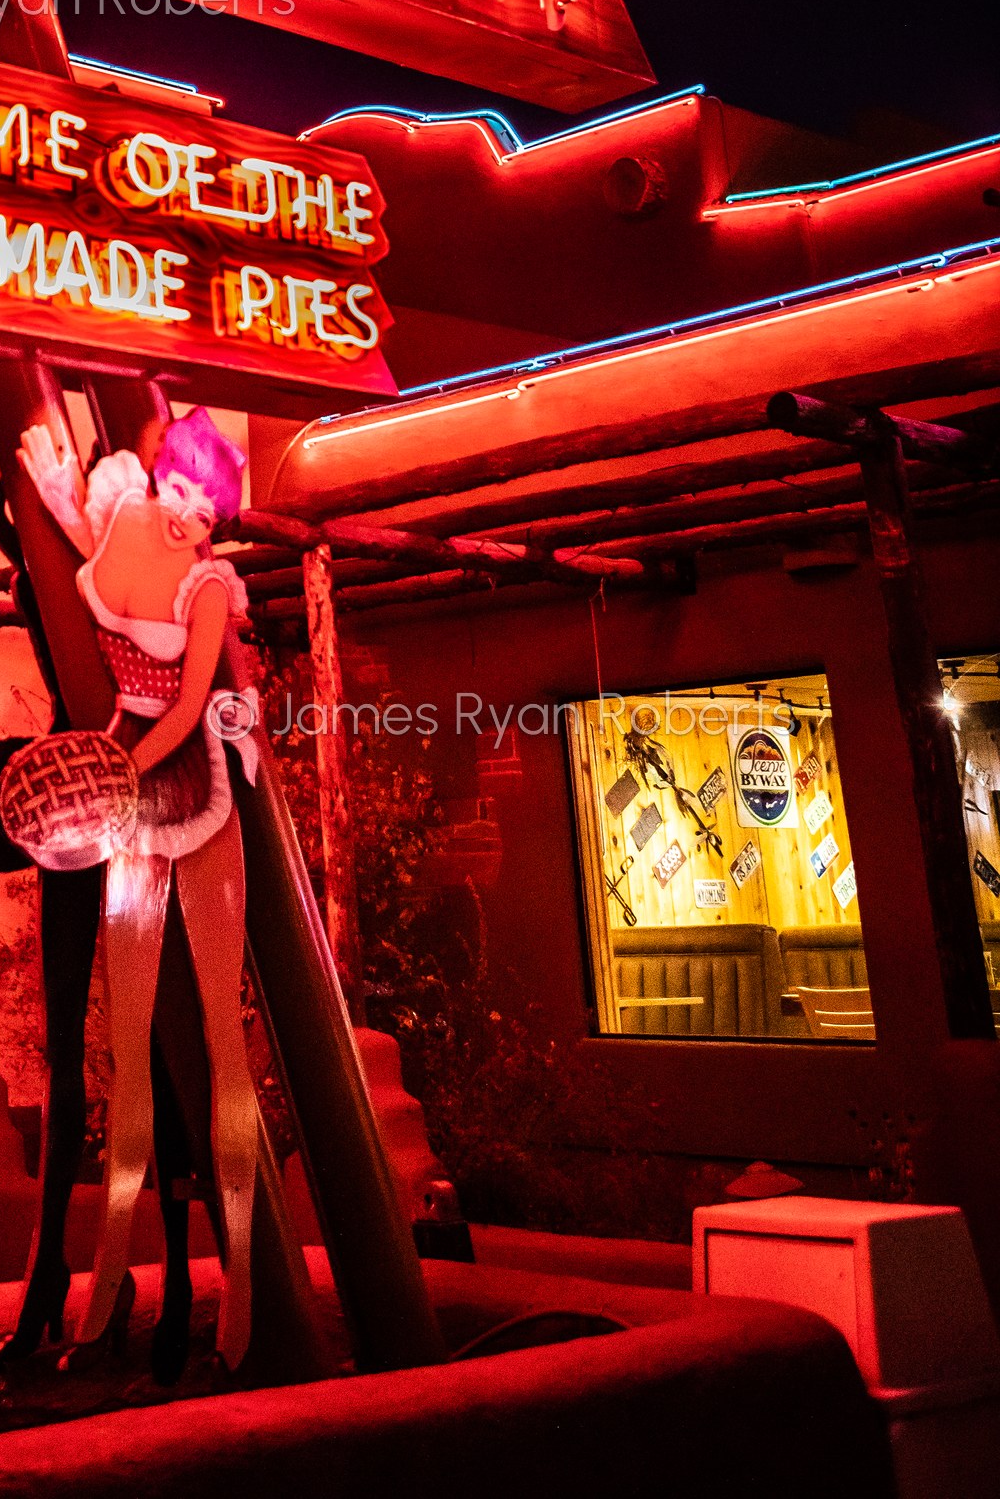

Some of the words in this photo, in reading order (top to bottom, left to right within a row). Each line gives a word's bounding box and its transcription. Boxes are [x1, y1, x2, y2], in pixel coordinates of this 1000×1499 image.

[104, 132, 217, 210] OF
[234, 157, 374, 248] THE
[213, 265, 378, 360] PIES
[738, 740, 786, 777] Scenic
[740, 773, 787, 787] BYWAY
